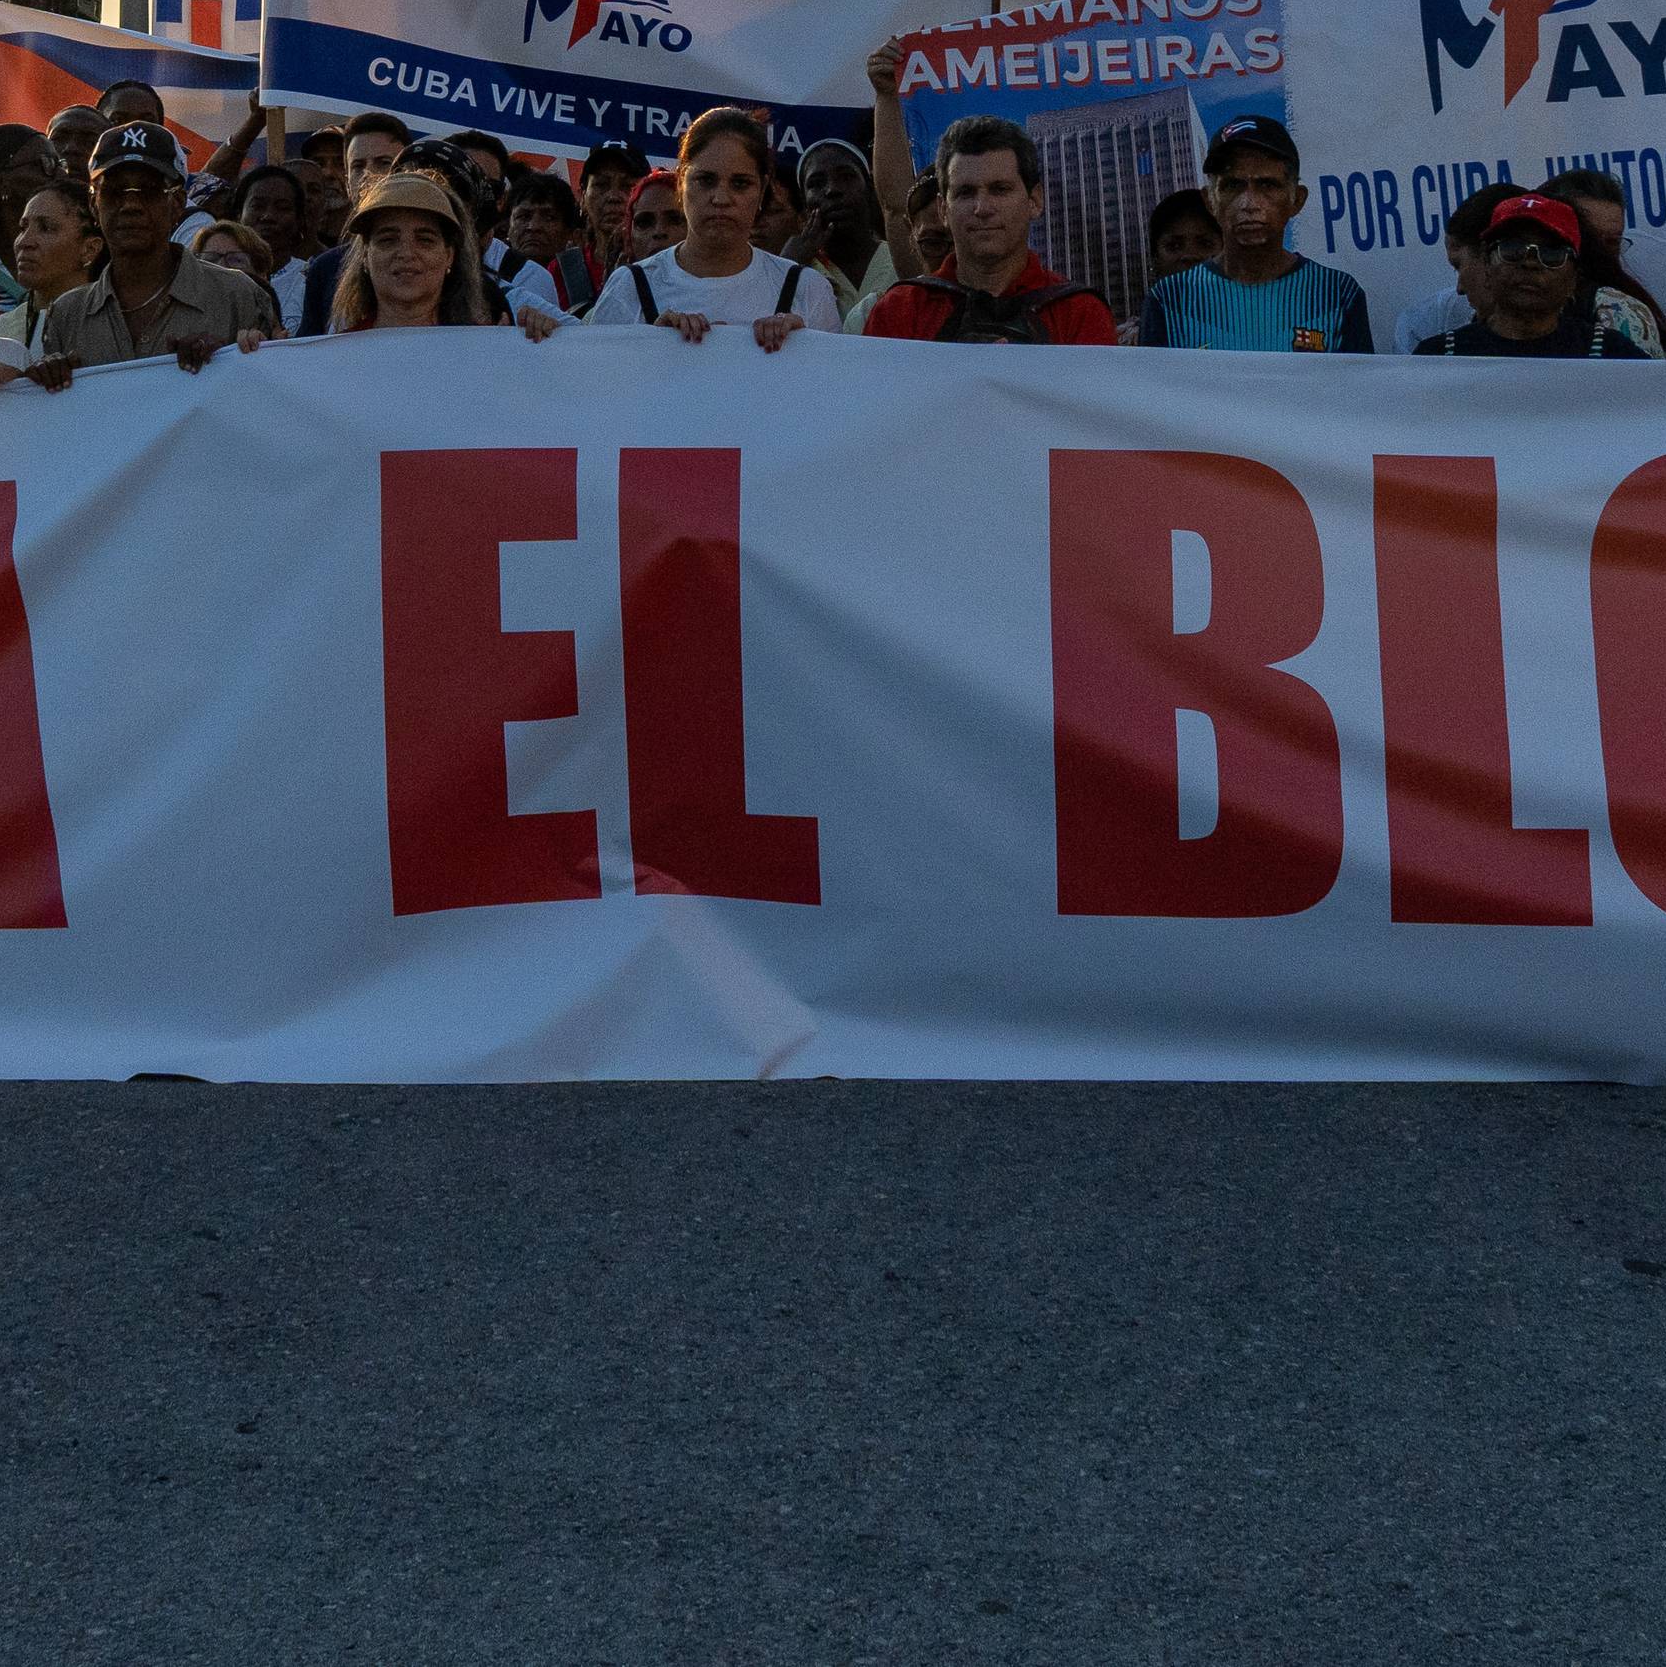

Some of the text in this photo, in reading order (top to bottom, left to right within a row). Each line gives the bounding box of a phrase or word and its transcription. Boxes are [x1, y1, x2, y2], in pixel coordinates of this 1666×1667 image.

[368, 57, 477, 107] CUBA
[491, 83, 576, 124] VIVE
[587, 98, 611, 127] Y
[899, 28, 1282, 93] AMEIJEIRAS
[122, 128, 147, 147] NY
[1319, 170, 1405, 253] POR
[380, 447, 821, 918] EL
